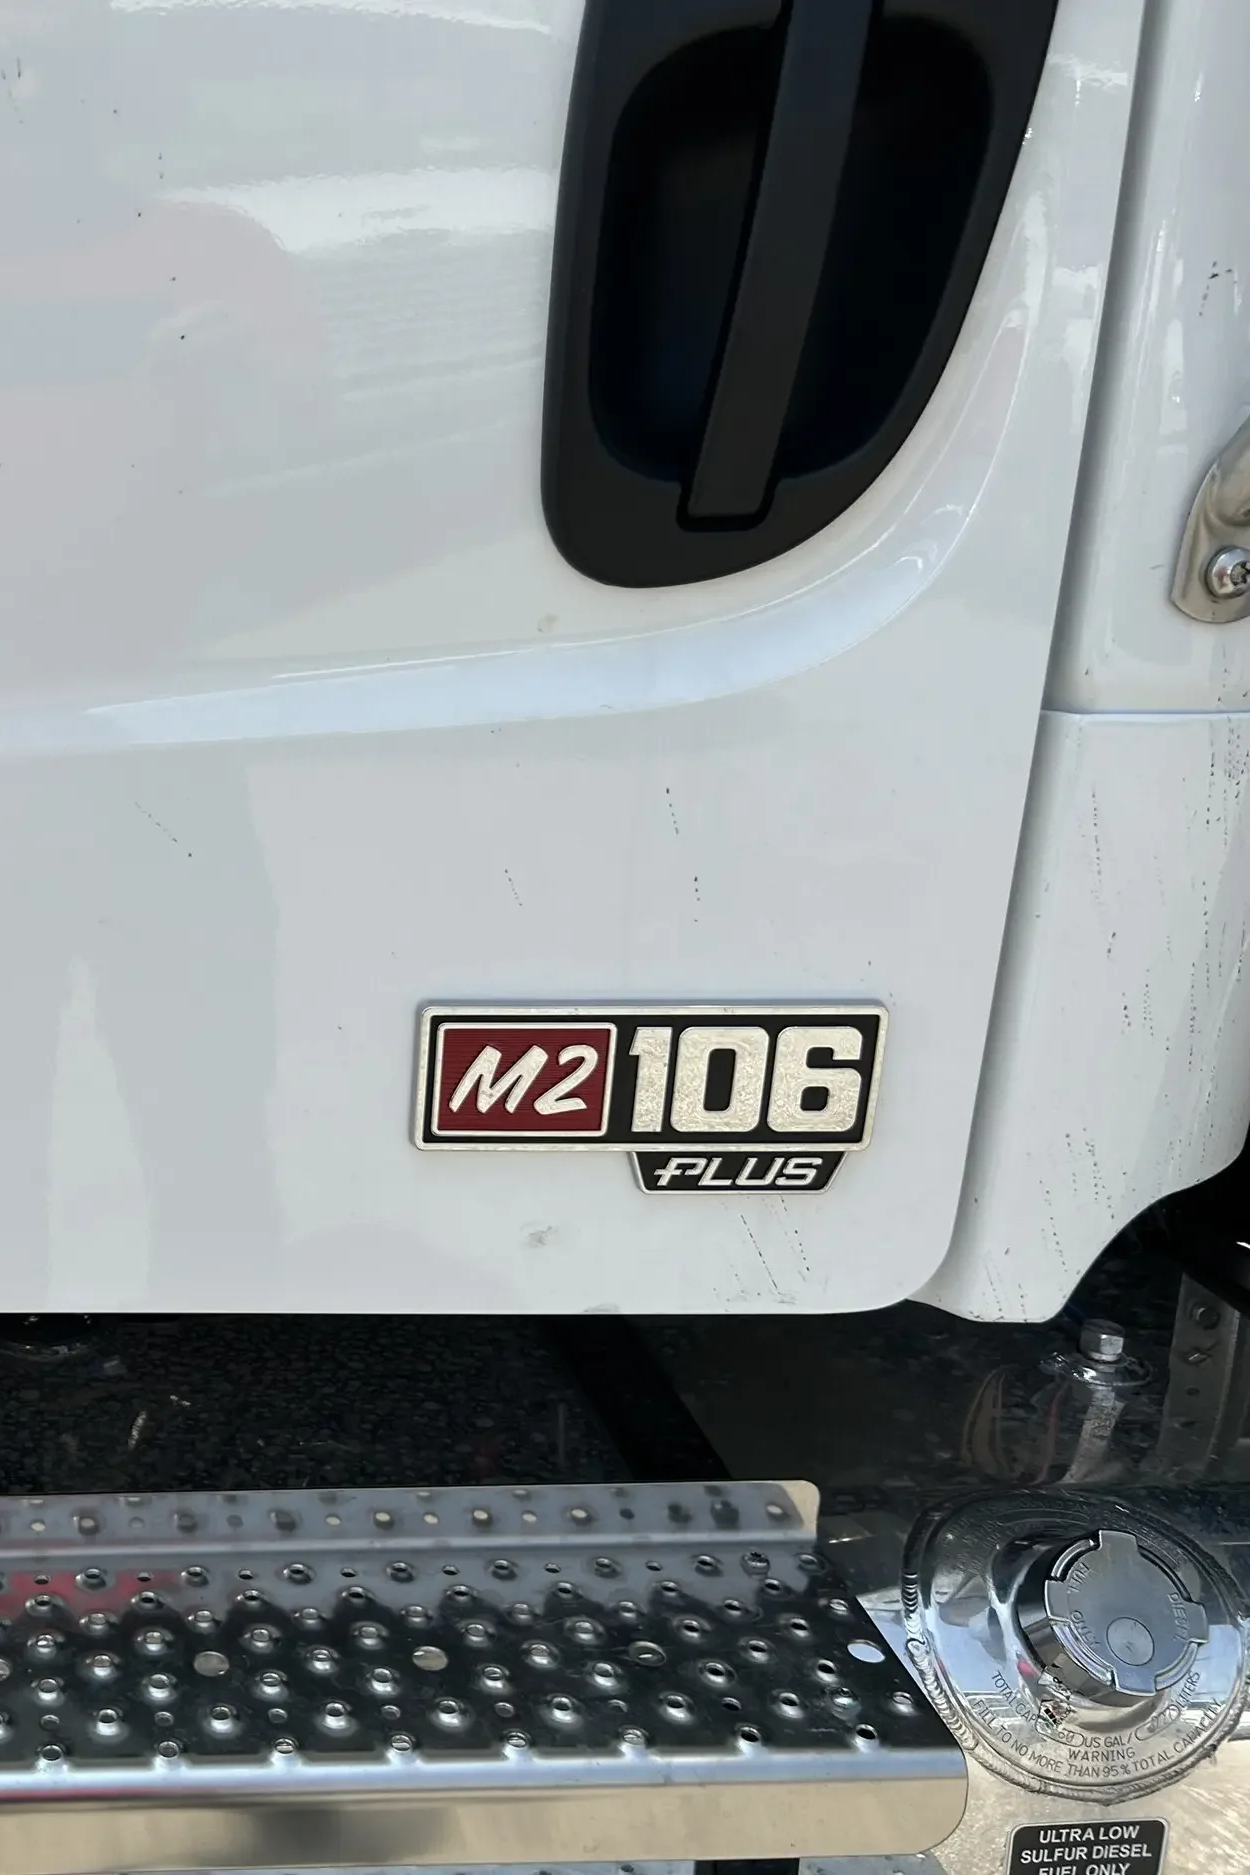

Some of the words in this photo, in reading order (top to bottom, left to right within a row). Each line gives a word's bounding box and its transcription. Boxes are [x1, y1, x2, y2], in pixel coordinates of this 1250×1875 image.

[448, 1043, 600, 1116] M2
[628, 1025, 863, 1134] 106
[653, 1155, 824, 1188] PLUS
[991, 1670, 1016, 1706] TOTAL
[1084, 1736, 1100, 1749] US
[1179, 1670, 1201, 1710] LITERS
[973, 1699, 996, 1729] FILL
[996, 1725, 1012, 1744] TO
[1011, 1741, 1029, 1757] NO
[1030, 1751, 1064, 1773] MORE
[1067, 1763, 1099, 1778] THAN
[1132, 1749, 1174, 1772] TOTAL
[1069, 1746, 1136, 1761] WARNING
[1039, 1827, 1094, 1844] ULTRA
[1098, 1825, 1140, 1840] LOW
[1020, 1846, 1087, 1864] SULFUR
[1092, 1843, 1152, 1859] DIESEL
[1085, 1863, 1130, 1875] ONLY
